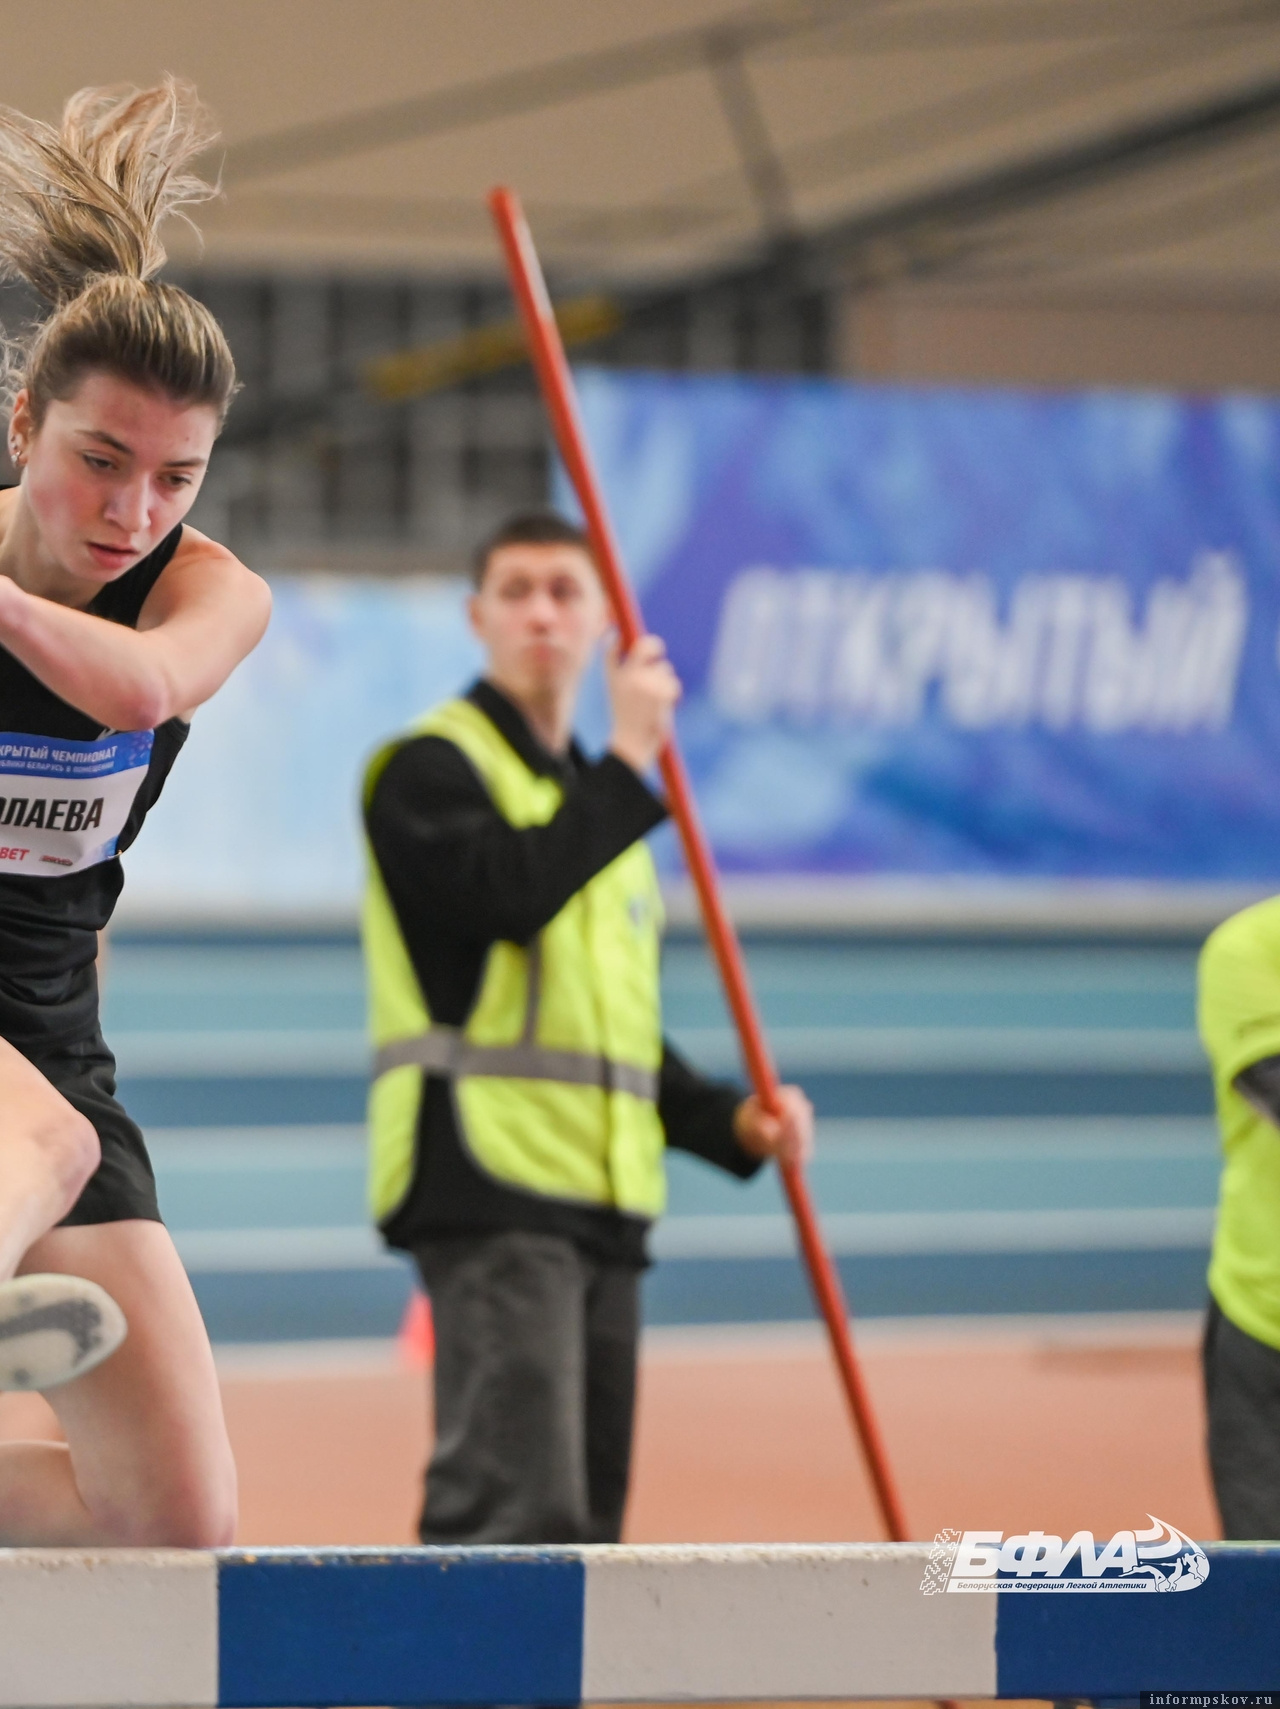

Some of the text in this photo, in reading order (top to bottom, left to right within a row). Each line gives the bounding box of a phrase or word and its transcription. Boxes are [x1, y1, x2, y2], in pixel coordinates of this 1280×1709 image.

[713, 550, 1248, 734] ОТКРЫТЫЙ
[51, 745, 118, 763] ЧЕМПИОНАТ
[26, 761, 64, 772] БЕЛАРУСЬ
